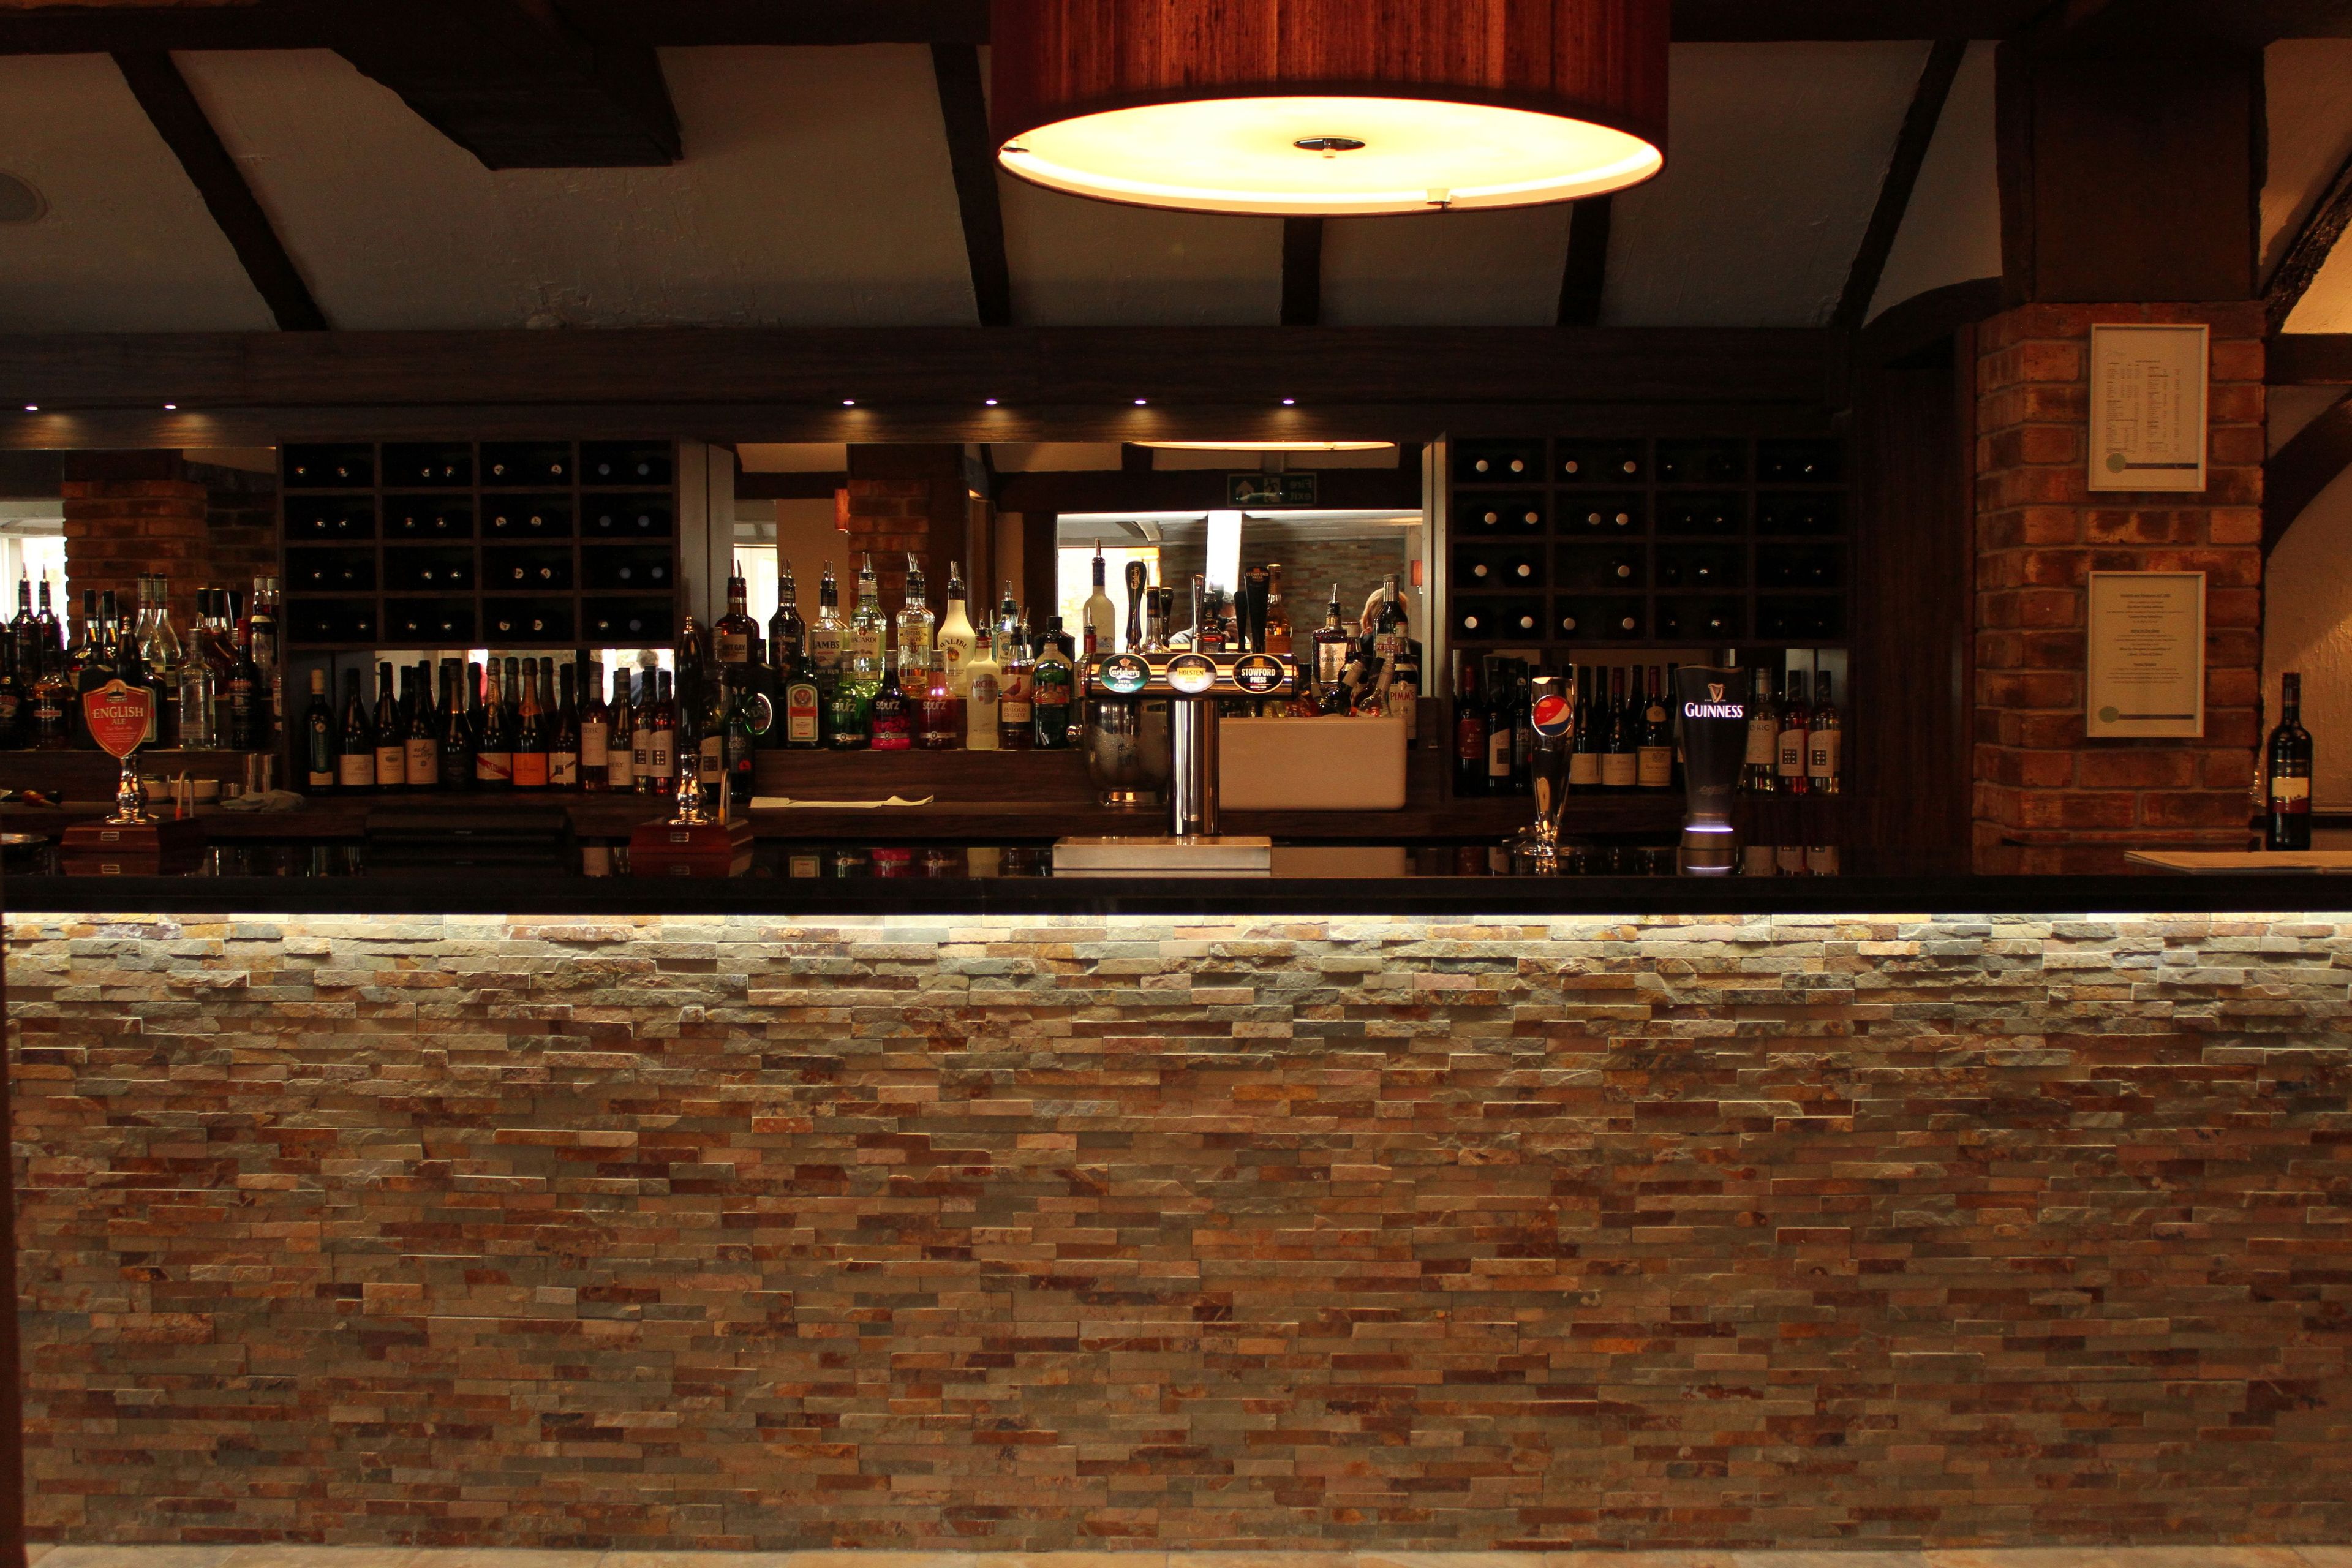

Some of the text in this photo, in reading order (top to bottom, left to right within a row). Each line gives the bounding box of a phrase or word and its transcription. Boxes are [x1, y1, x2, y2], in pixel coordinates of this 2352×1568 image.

[940, 638, 968, 650] MALIBU
[1109, 666, 1140, 679] Carlsberg
[1241, 668, 1276, 676] STOWFORD
[1390, 690, 1415, 701] PIMM'S
[92, 706, 144, 719] ENGLISH
[1684, 702, 1744, 718] GUINNESS
